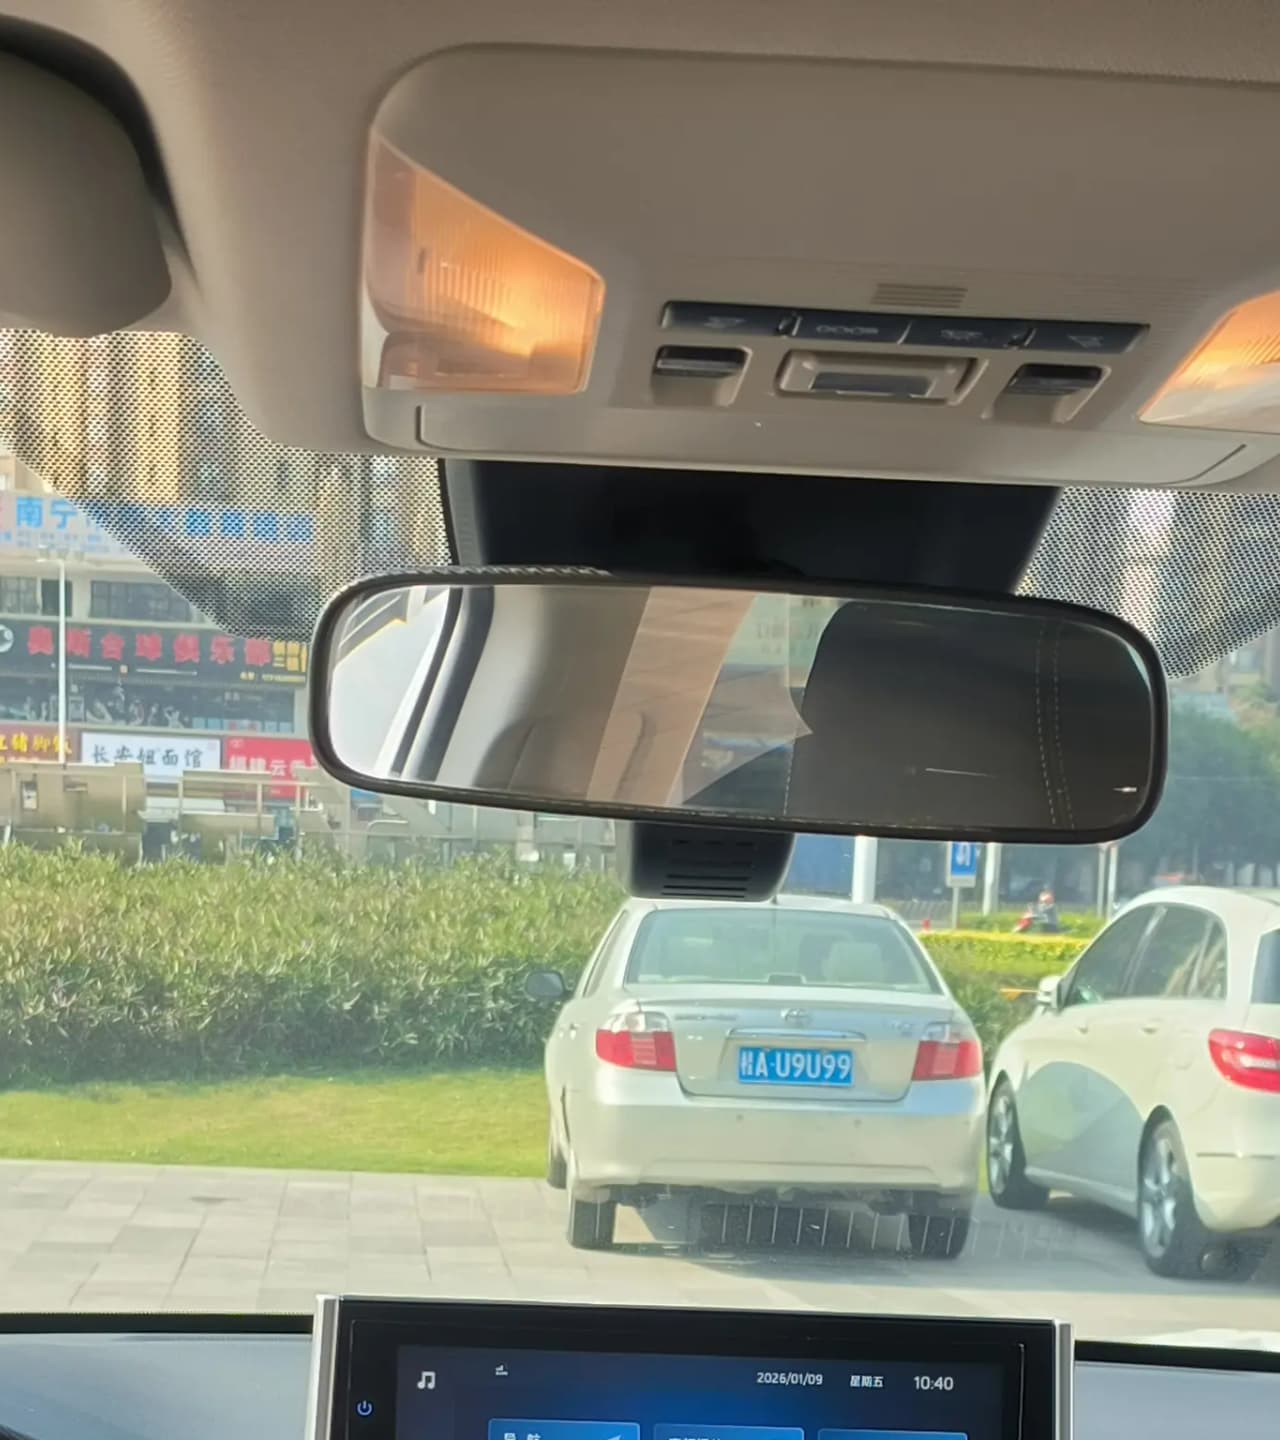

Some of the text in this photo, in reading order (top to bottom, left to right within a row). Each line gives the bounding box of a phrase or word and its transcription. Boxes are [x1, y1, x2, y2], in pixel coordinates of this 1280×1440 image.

[756, 1372, 823, 1386] 2026/01/09
[849, 1375, 884, 1389] 星期五
[914, 1376, 954, 1391] 10:40
